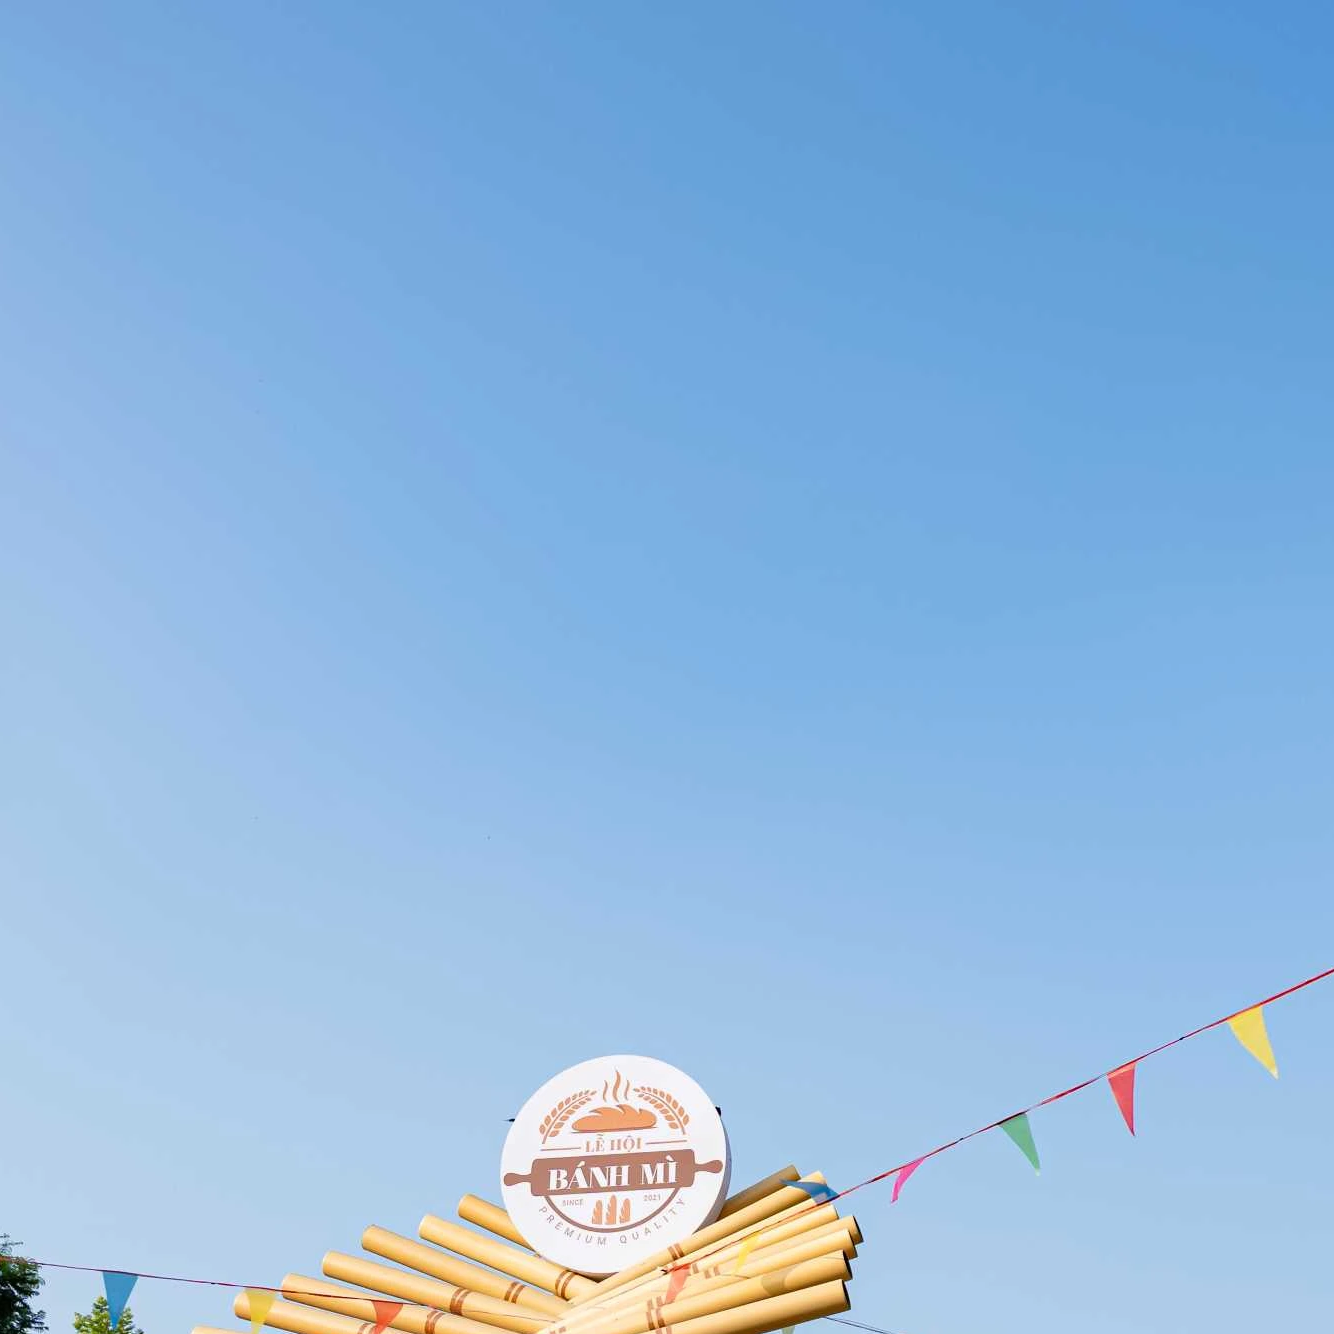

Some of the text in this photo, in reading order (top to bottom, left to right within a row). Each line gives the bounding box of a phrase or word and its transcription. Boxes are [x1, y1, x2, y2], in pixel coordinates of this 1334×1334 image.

[585, 1134, 643, 1153] LỄ HỘI
[547, 1155, 679, 1191] BÁNH MÌ
[562, 1198, 584, 1207] SINCE
[643, 1193, 662, 1202] 2021
[538, 1197, 687, 1246] PREMIUM QUALITY
